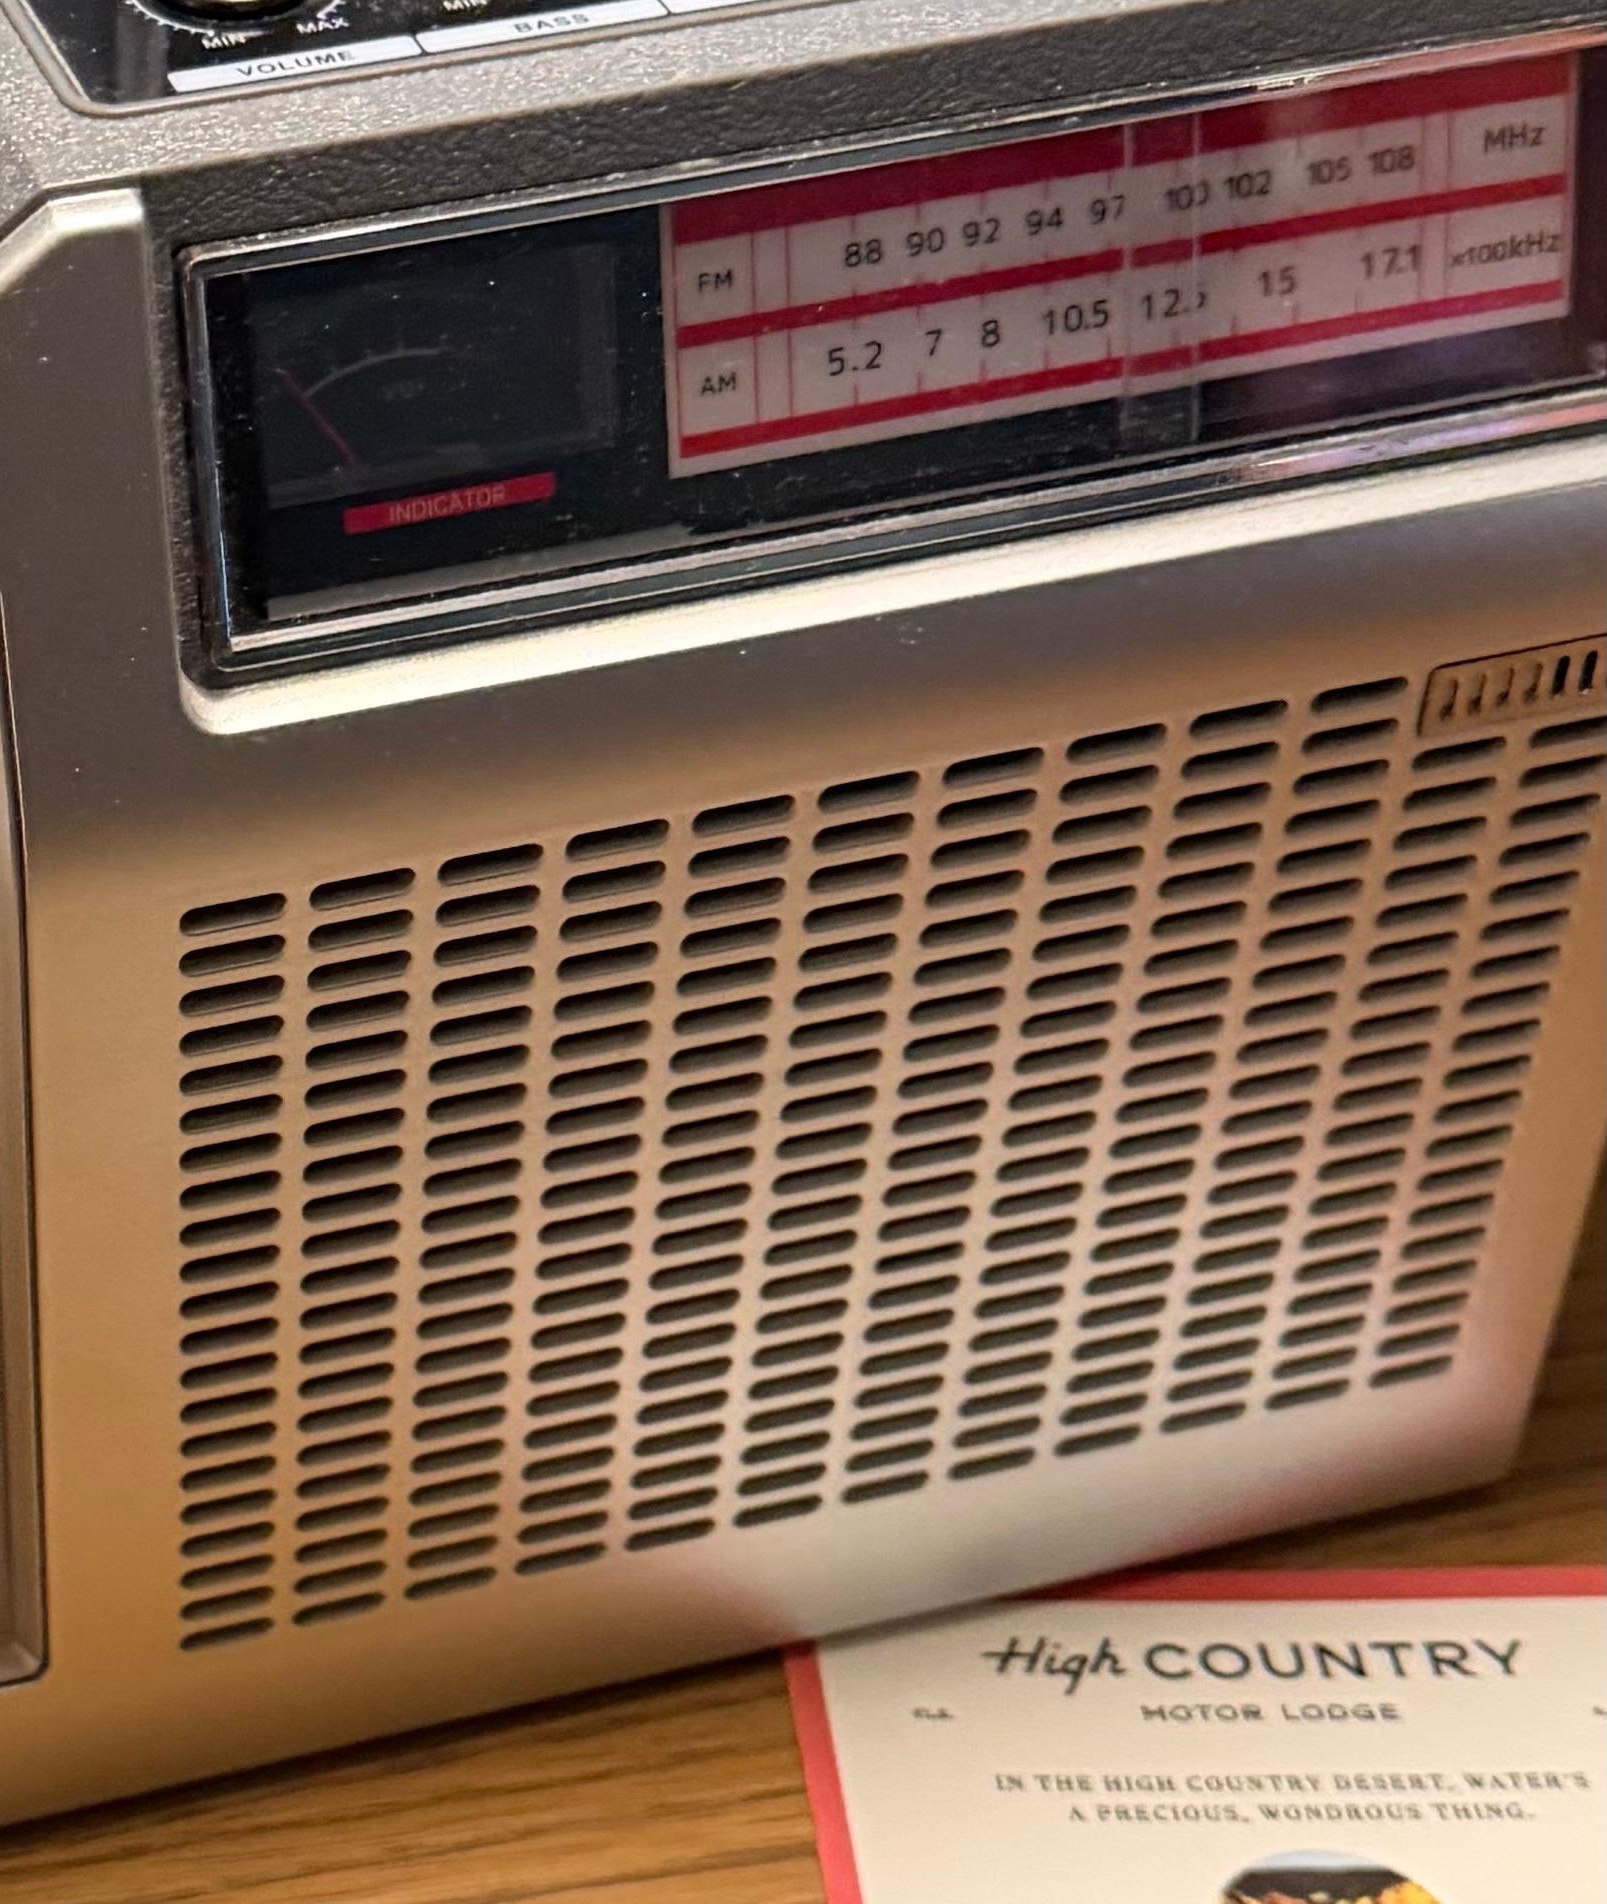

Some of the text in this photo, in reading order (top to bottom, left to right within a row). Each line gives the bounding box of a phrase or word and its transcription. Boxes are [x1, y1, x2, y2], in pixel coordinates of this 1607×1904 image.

[296, 16, 350, 34] MAX
[513, 12, 590, 34] BASS
[201, 32, 246, 50] MIN
[236, 50, 356, 77] VOLUME
[697, 269, 733, 292] FM
[844, 238, 883, 268] 88
[906, 227, 945, 258] 90
[962, 217, 1001, 247] 92
[1025, 206, 1064, 236] 94
[1088, 195, 1125, 225] 97
[1223, 169, 1273, 201] 102
[1306, 156, 1353, 186] 105
[1367, 145, 1416, 175] 108
[1483, 123, 1547, 153] MHz
[700, 371, 738, 395] AM
[827, 341, 884, 377] 5.2
[924, 329, 944, 357] 7
[980, 319, 1003, 349] 8
[1043, 298, 1111, 336] 10.5
[1258, 265, 1298, 298] 15
[387, 484, 507, 526] INDICATOR
[980, 1636, 1524, 1697] High COUNTRY
[1140, 1702, 1403, 1723] MOTOR LODGE
[994, 1774, 1025, 1793] IN
[1033, 1774, 1094, 1793] THE
[1102, 1774, 1177, 1793] HIGH
[1185, 1773, 1322, 1793] COUNTRY
[1068, 1805, 1088, 1823] A
[1256, 1802, 1424, 1823] WONDROUS
